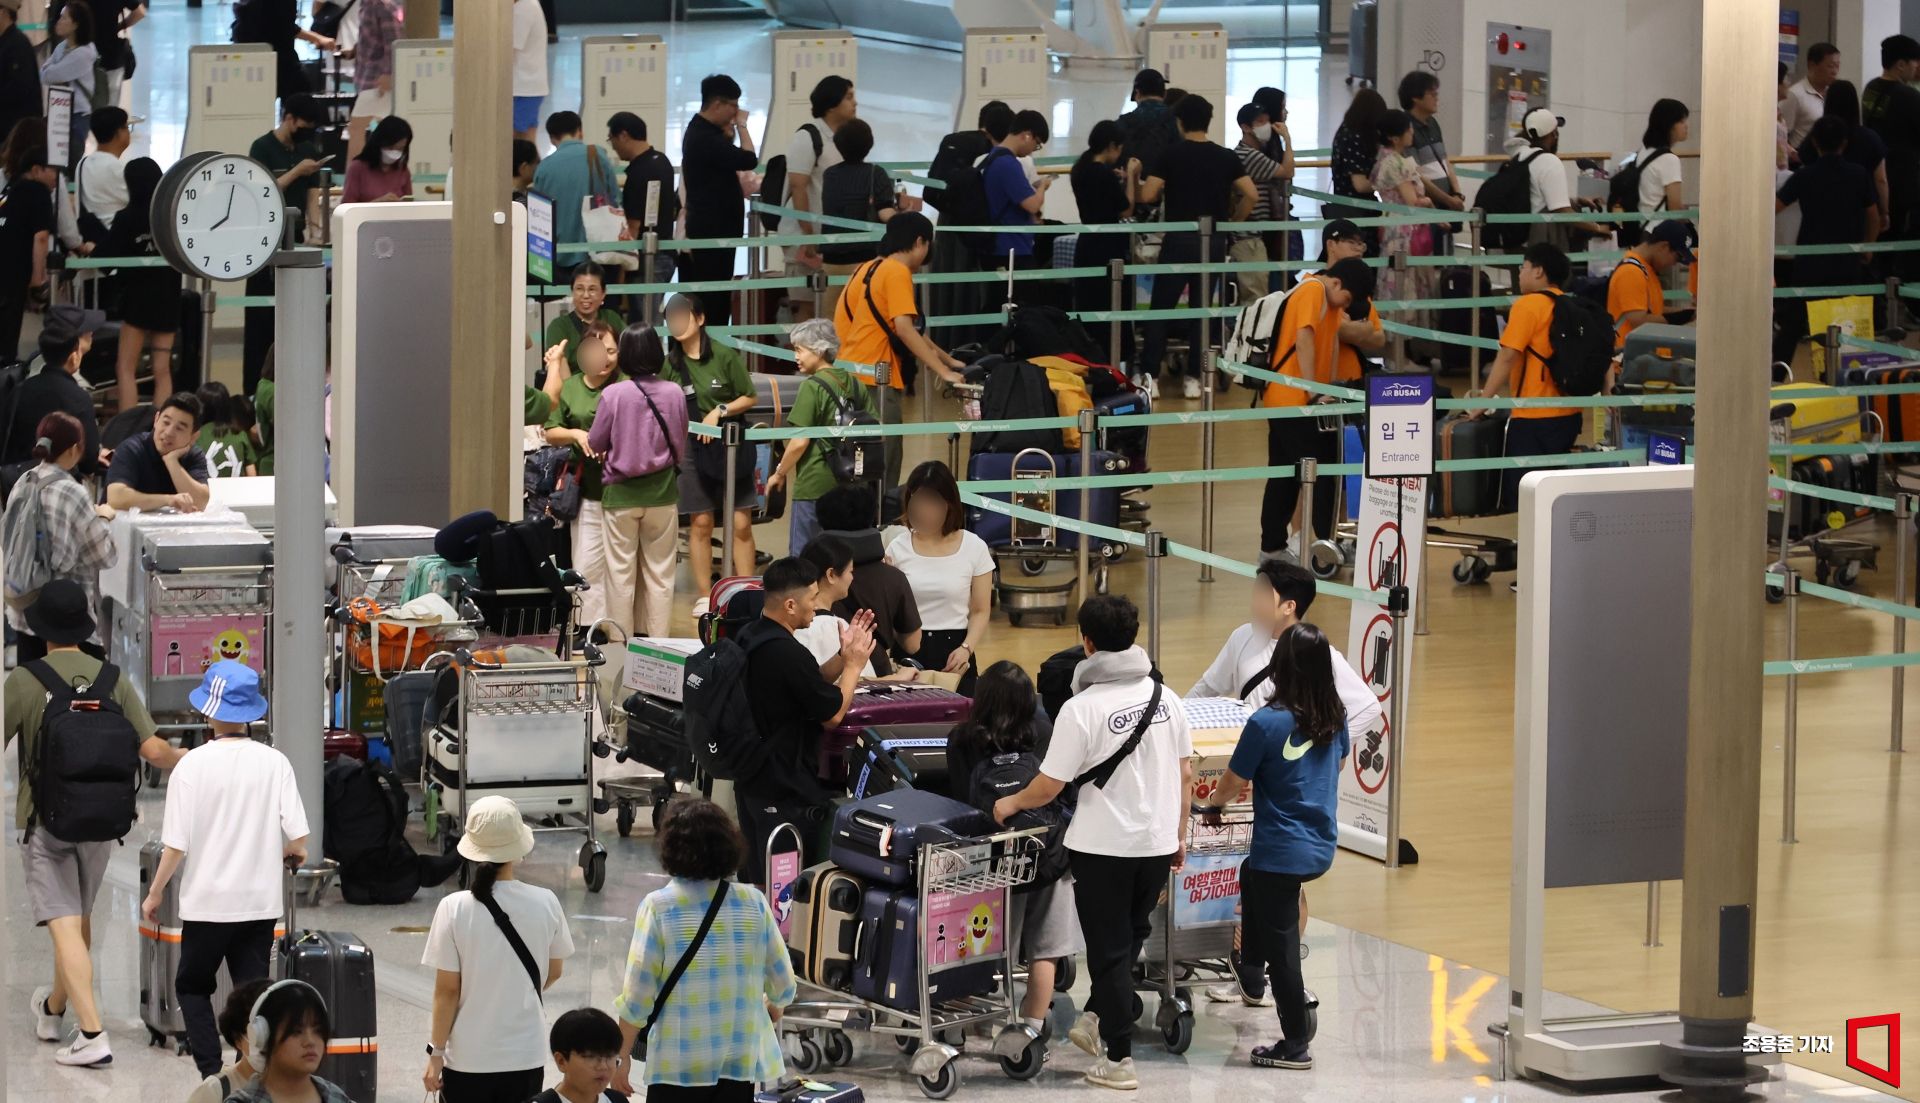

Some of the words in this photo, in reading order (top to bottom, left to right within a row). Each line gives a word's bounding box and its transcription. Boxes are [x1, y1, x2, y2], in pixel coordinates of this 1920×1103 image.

[224, 164, 234, 175] 12
[248, 170, 252, 180] 1
[202, 170, 212, 181] 11
[185, 189, 196, 200] 10
[263, 187, 270, 198] 2
[182, 214, 188, 224] 9
[268, 211, 275, 222] 3
[187, 238, 194, 248] 8
[261, 236, 268, 247] 4
[203, 256, 210, 267] 7
[246, 255, 252, 265] 5
[224, 261, 231, 272] 6
[1394, 389, 1421, 397] BUSAN
[1382, 451, 1420, 462] Entrance
[1184, 866, 1237, 890] 여행할때
[1190, 880, 1240, 904] 여기어때
